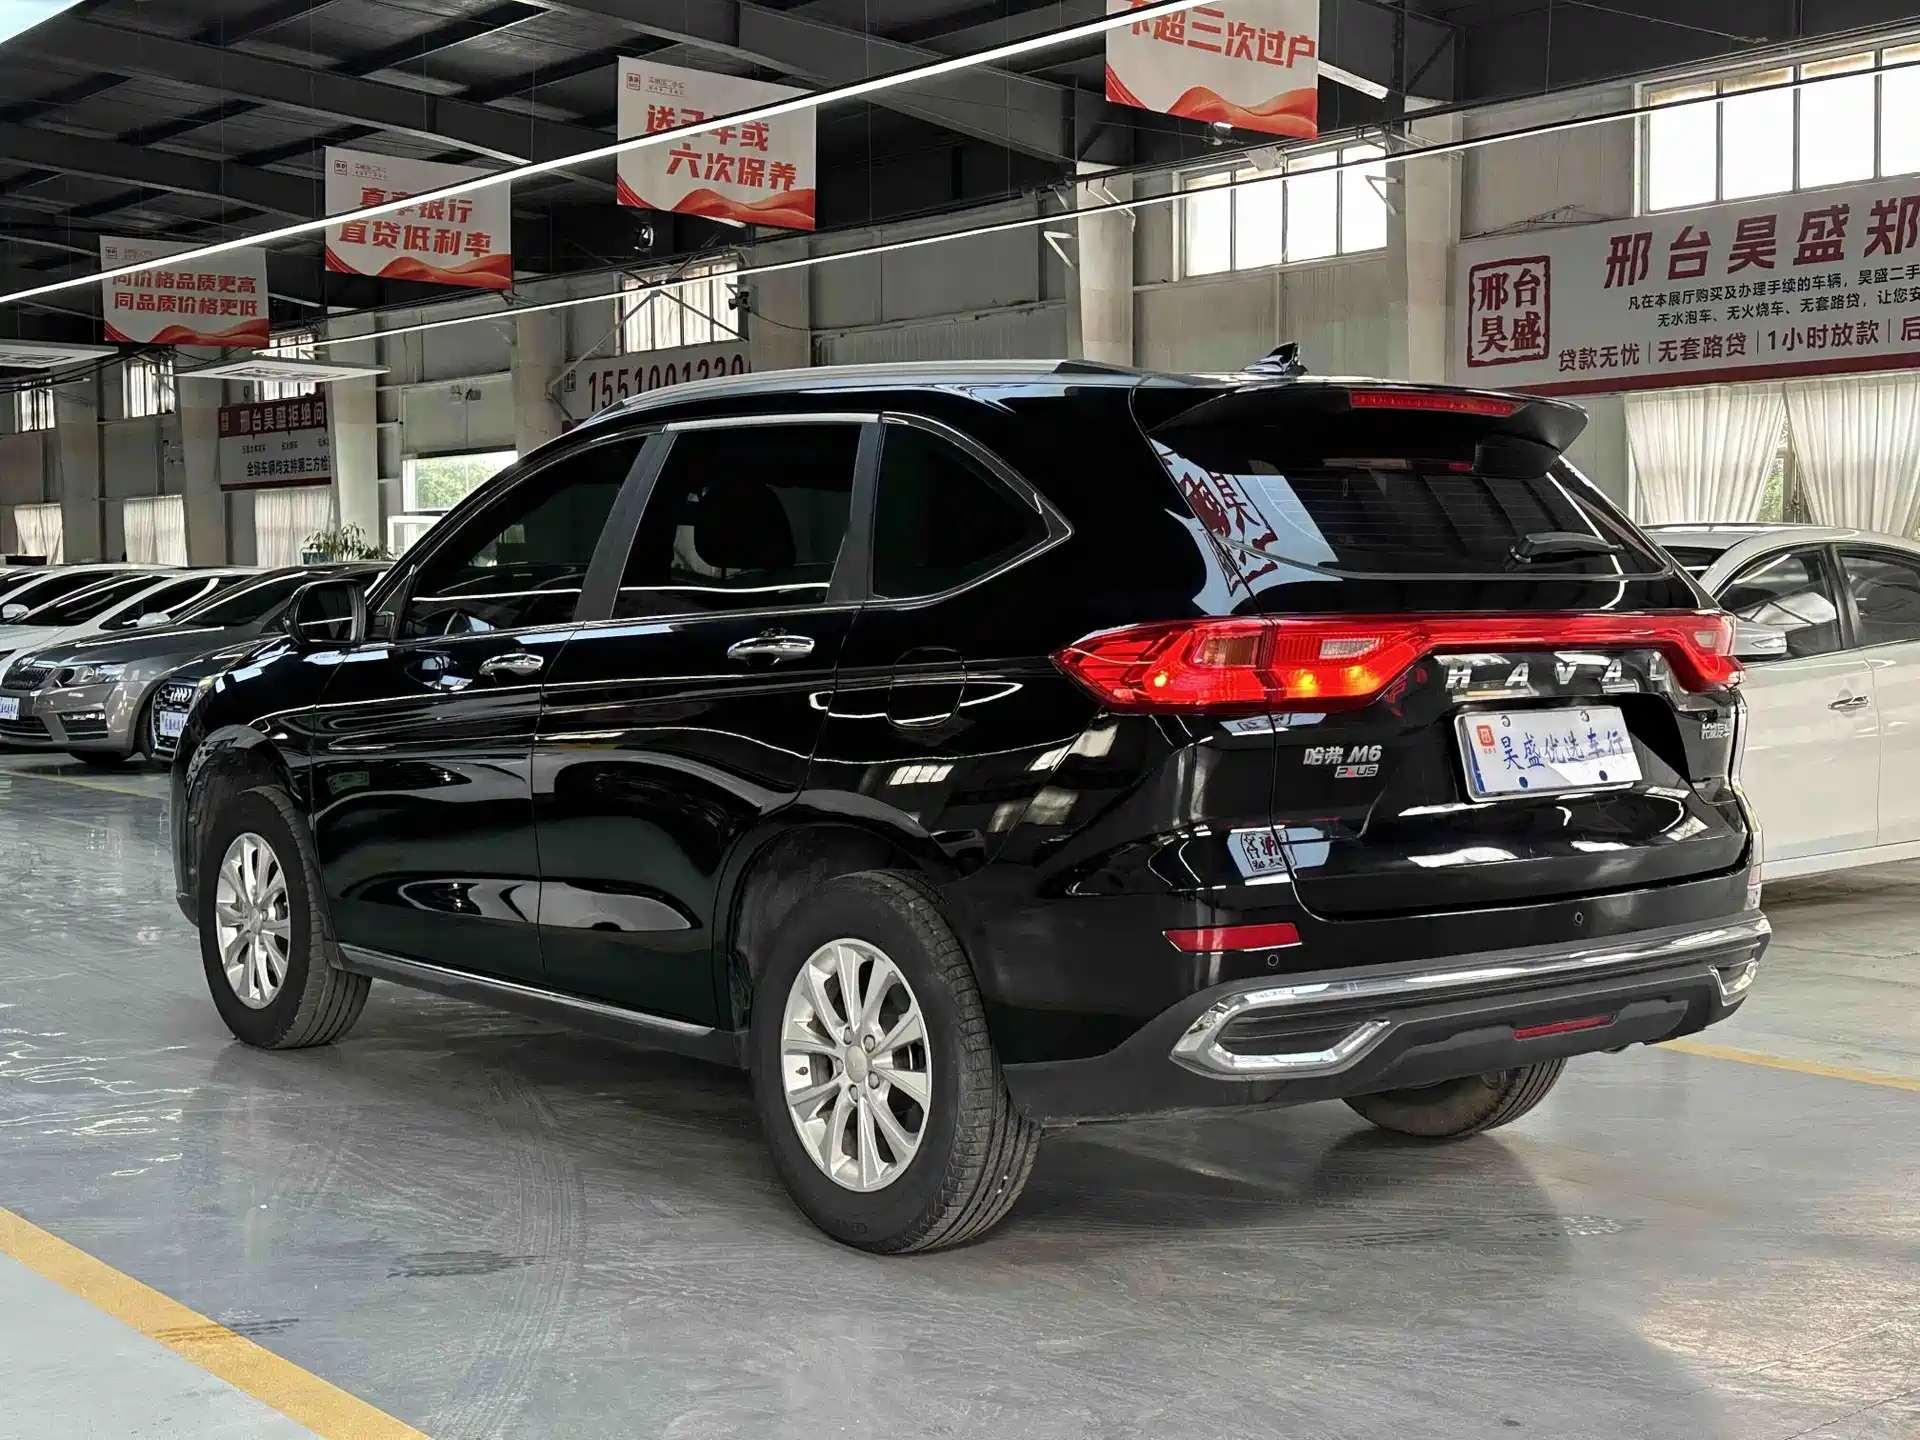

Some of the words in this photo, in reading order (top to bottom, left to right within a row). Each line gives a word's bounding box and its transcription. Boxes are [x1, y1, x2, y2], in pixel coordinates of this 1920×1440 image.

[667, 143, 797, 192] 六次保养
[339, 219, 492, 258] 直贷低利率
[1604, 195, 1920, 289] 邢台昊盛郑
[114, 291, 258, 317] 同品质价格更低
[1477, 267, 1541, 311] 邢台
[1477, 311, 1542, 355] 昊盛
[1559, 343, 1640, 372] 贷款无忧
[1658, 332, 1747, 362] 无套路贷
[1767, 320, 1880, 351] 1小时放款
[1303, 746, 1344, 765] 哈弗
[1347, 745, 1383, 763] M6
